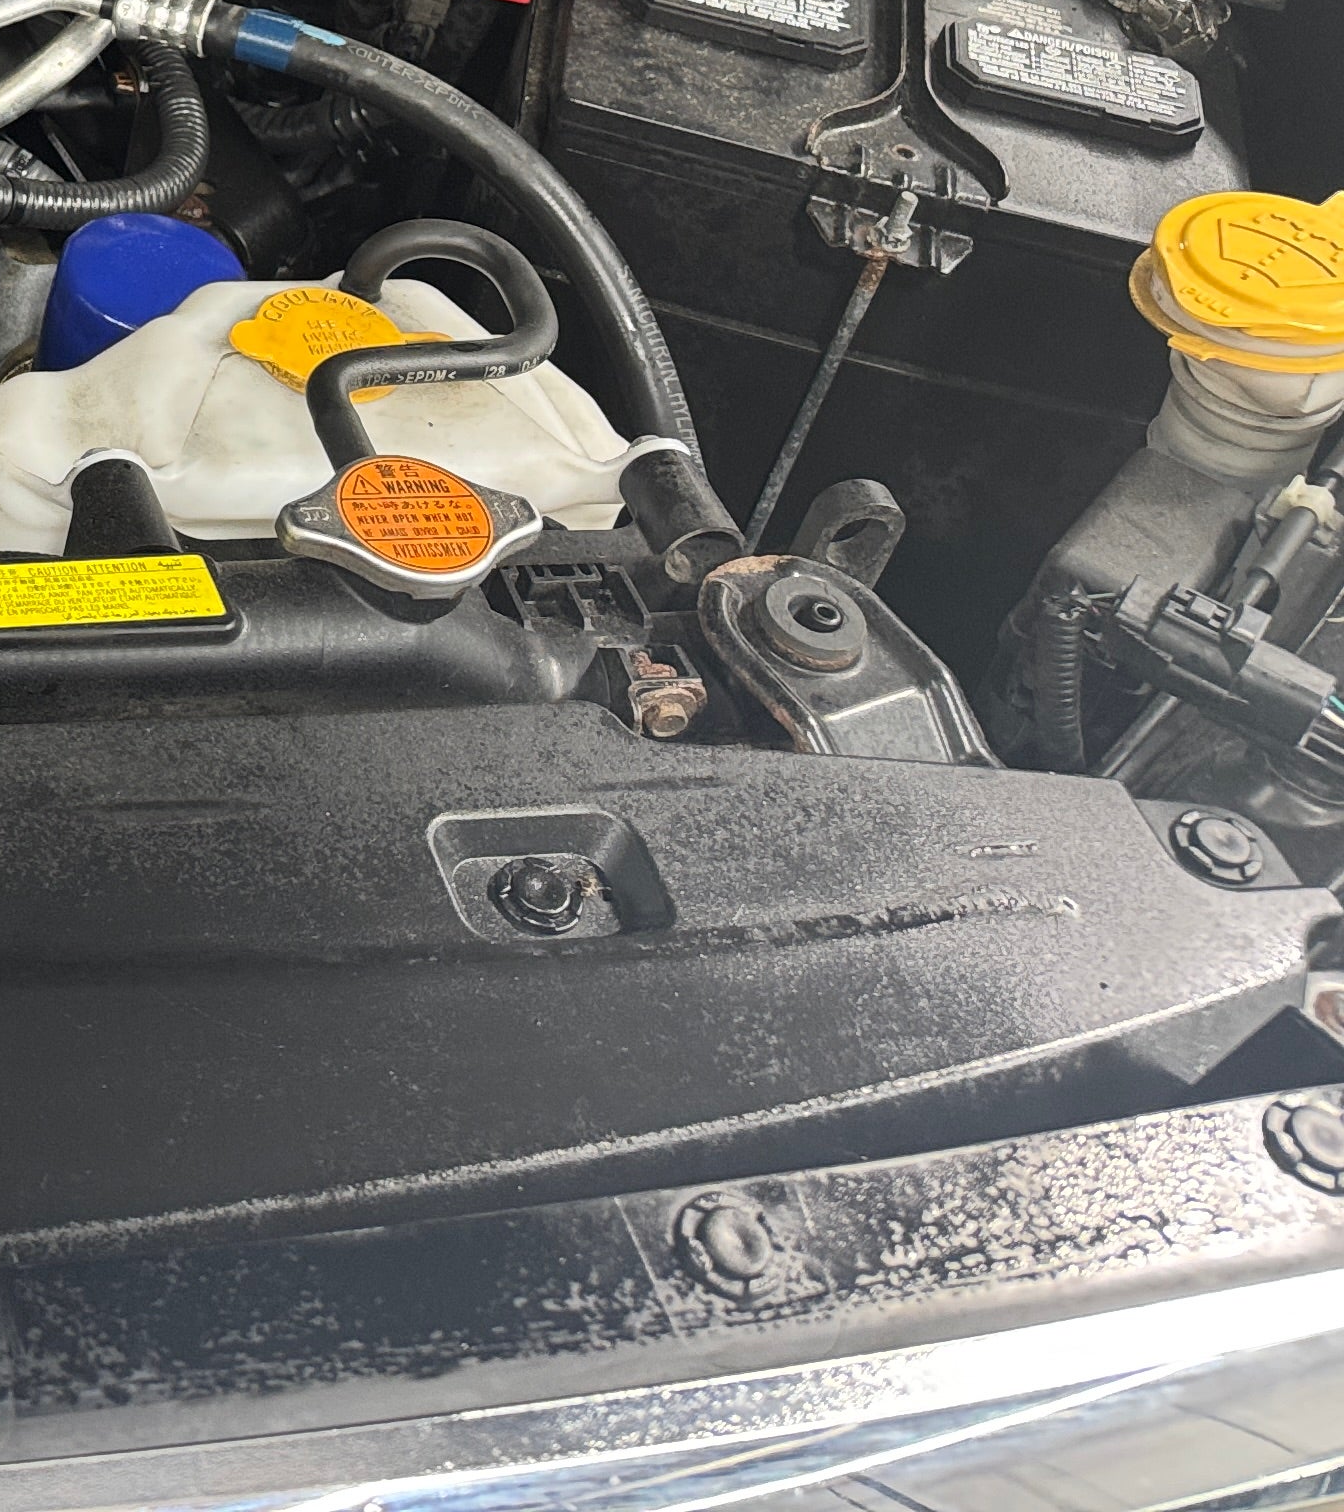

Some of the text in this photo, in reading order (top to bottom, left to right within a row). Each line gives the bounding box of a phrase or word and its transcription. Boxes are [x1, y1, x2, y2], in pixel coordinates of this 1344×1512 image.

[262, 290, 382, 322] COOLANT
[1179, 287, 1232, 318] PULL
[374, 463, 420, 478] 警告
[381, 479, 450, 495] WARNING
[357, 511, 474, 526] NEVER OPEN WHEN HOT
[28, 562, 147, 577] CAUTION ATTENTION
